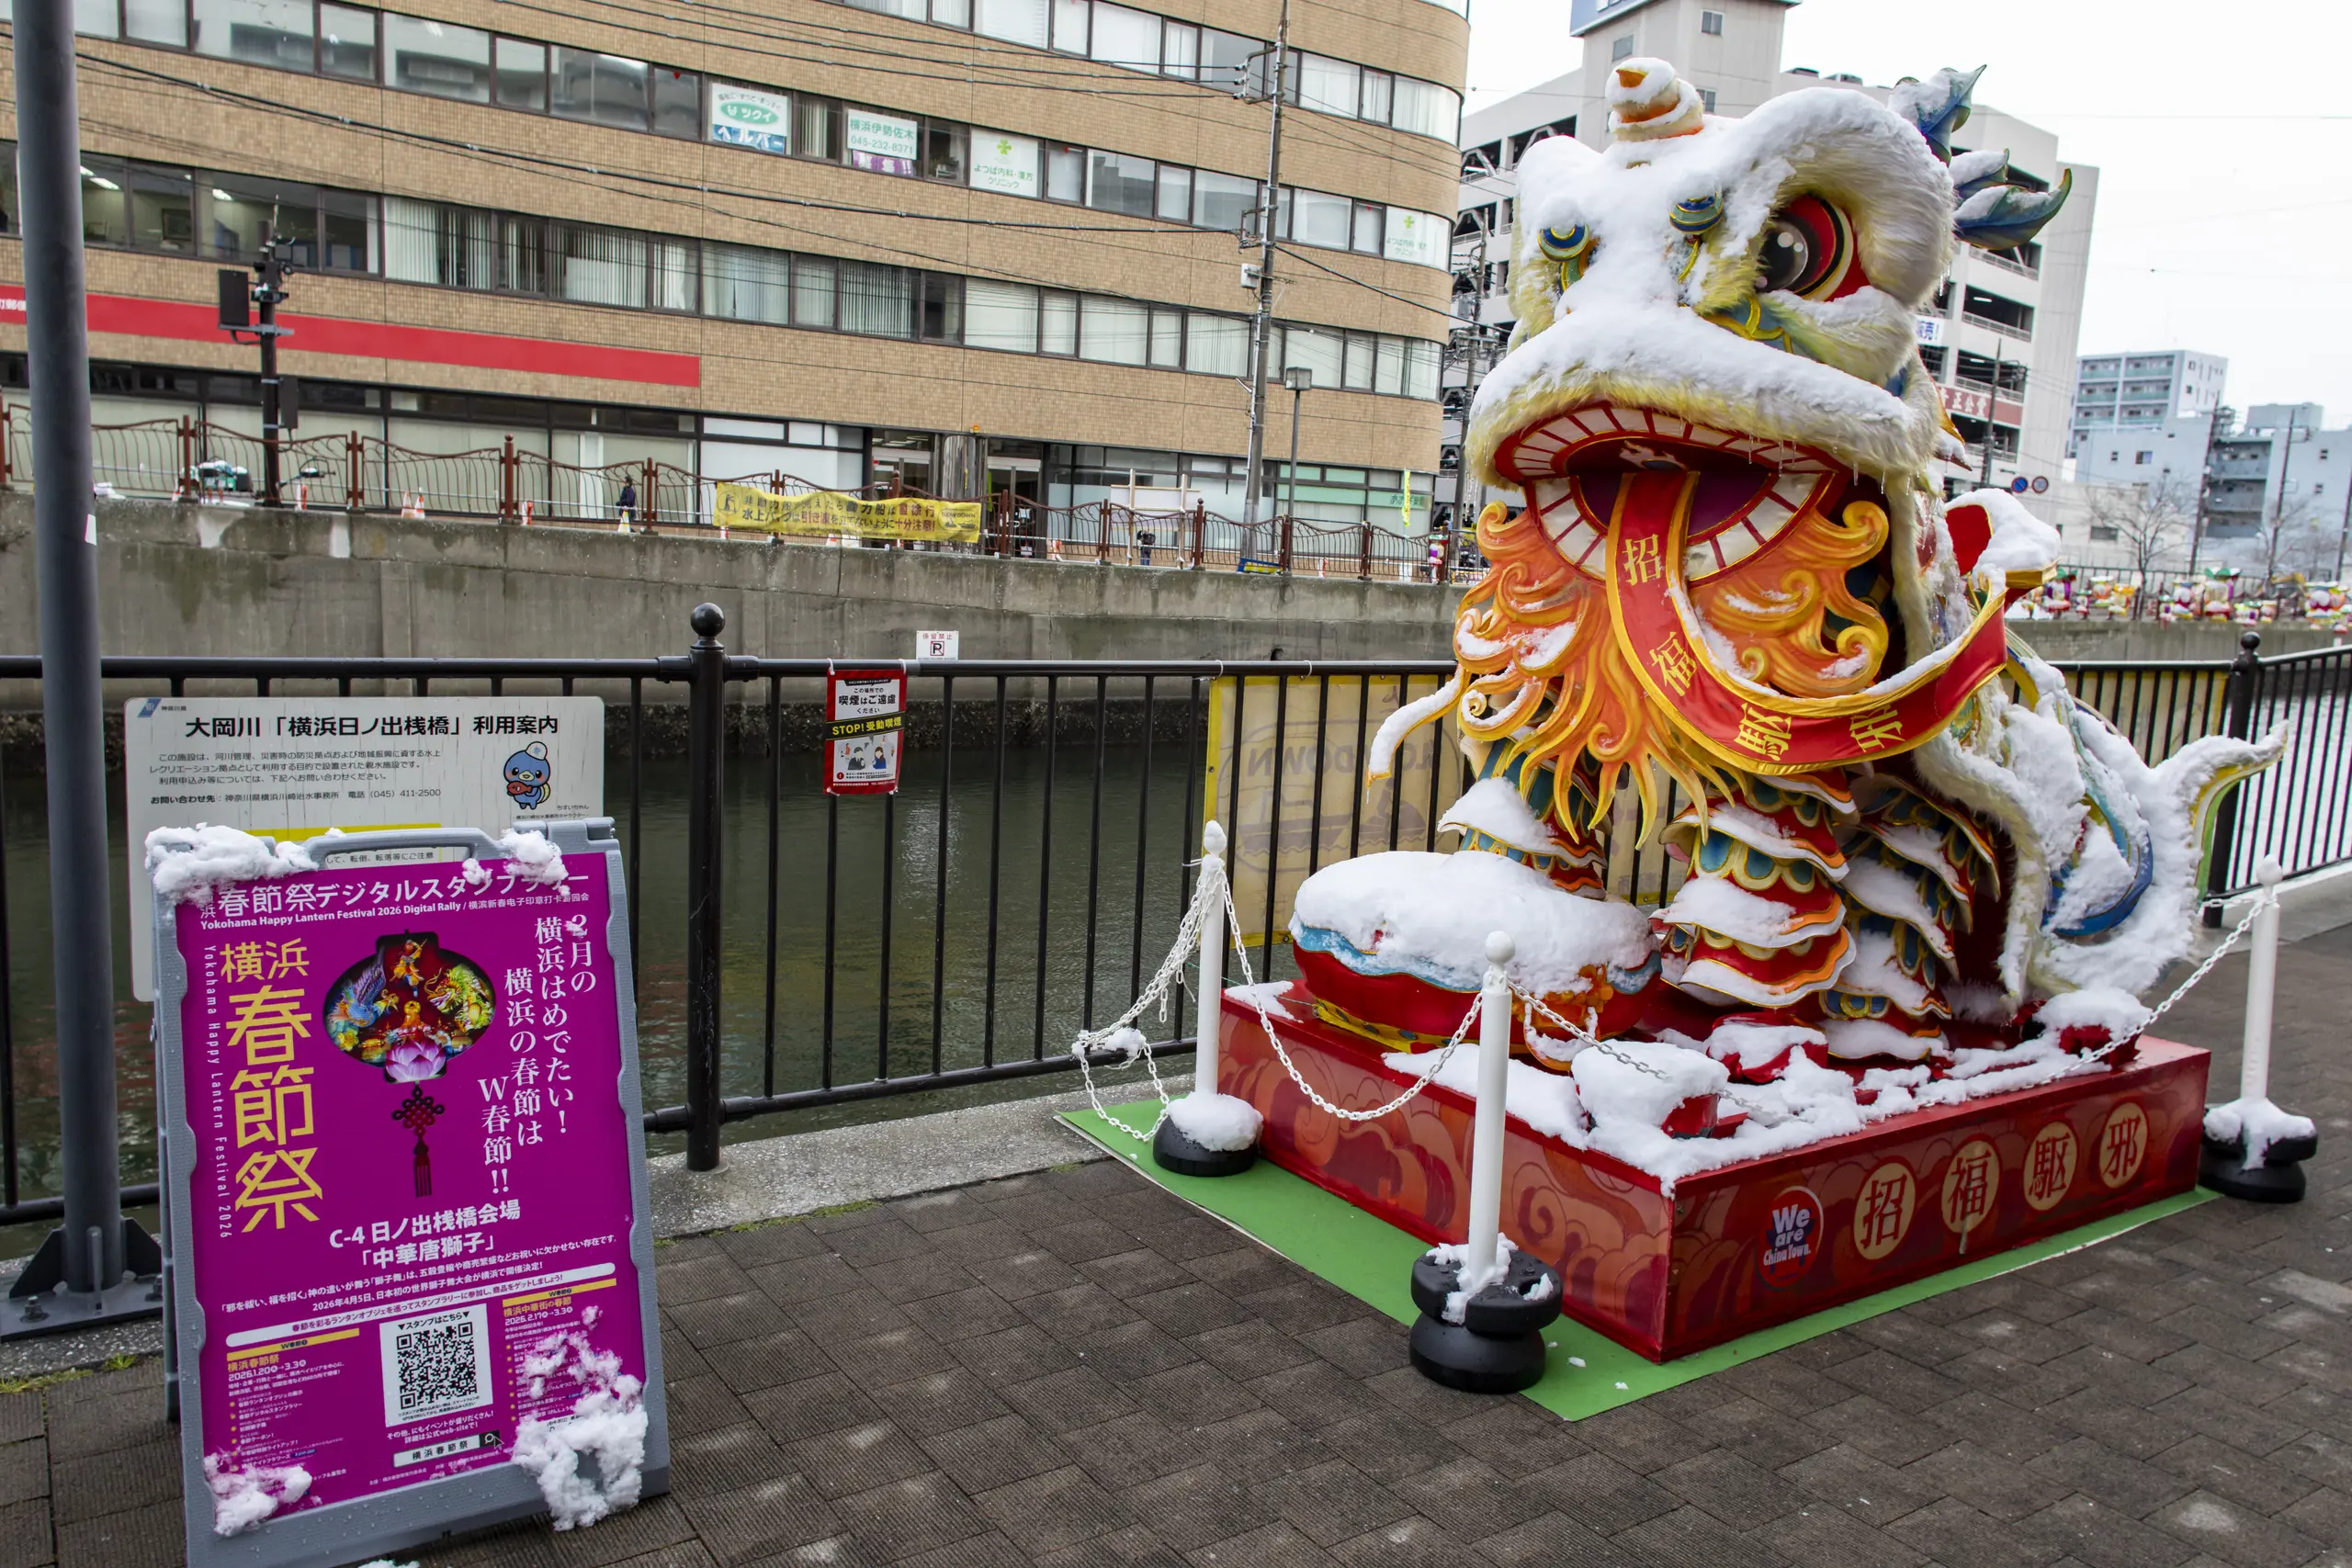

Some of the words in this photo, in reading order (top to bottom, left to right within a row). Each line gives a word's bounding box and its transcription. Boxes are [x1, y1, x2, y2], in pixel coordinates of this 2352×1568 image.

[741, 107, 772, 122] ツクイ
[850, 118, 914, 141] 横浜伊勢佐木
[839, 694, 896, 705] 喫煙はご遠慮
[186, 716, 459, 738] 大岡川「横浜日ノ出桟橋」
[473, 716, 559, 735] 利用案内
[832, 722, 865, 735] STOP!
[866, 716, 901, 731] 受動喫煙
[200, 918, 257, 931] Yokohama
[259, 915, 294, 928] Happy
[296, 910, 335, 922] Lantern
[337, 908, 376, 919] Festival
[378, 907, 401, 917] 2026
[403, 903, 435, 915] Digital
[438, 901, 461, 912] Rally
[220, 938, 310, 984] 横浜
[204, 945, 217, 1015] Yokohama
[535, 917, 574, 1134] 横浜はめでたい!
[208, 1022, 220, 1065] Happy
[504, 967, 544, 1146] 横浜の春節は
[211, 1073, 224, 1129] Lantern
[226, 985, 322, 1233] 春節祭
[215, 1136, 230, 1198] Festival
[219, 1204, 232, 1238] 2026
[1772, 1204, 1811, 1234] We
[362, 1231, 496, 1269] 「中華唐獅子」
[1775, 1228, 1804, 1247] are
[228, 1354, 279, 1372] 横浜春節祭
[412, 1440, 469, 1461] 横浜春節祭
